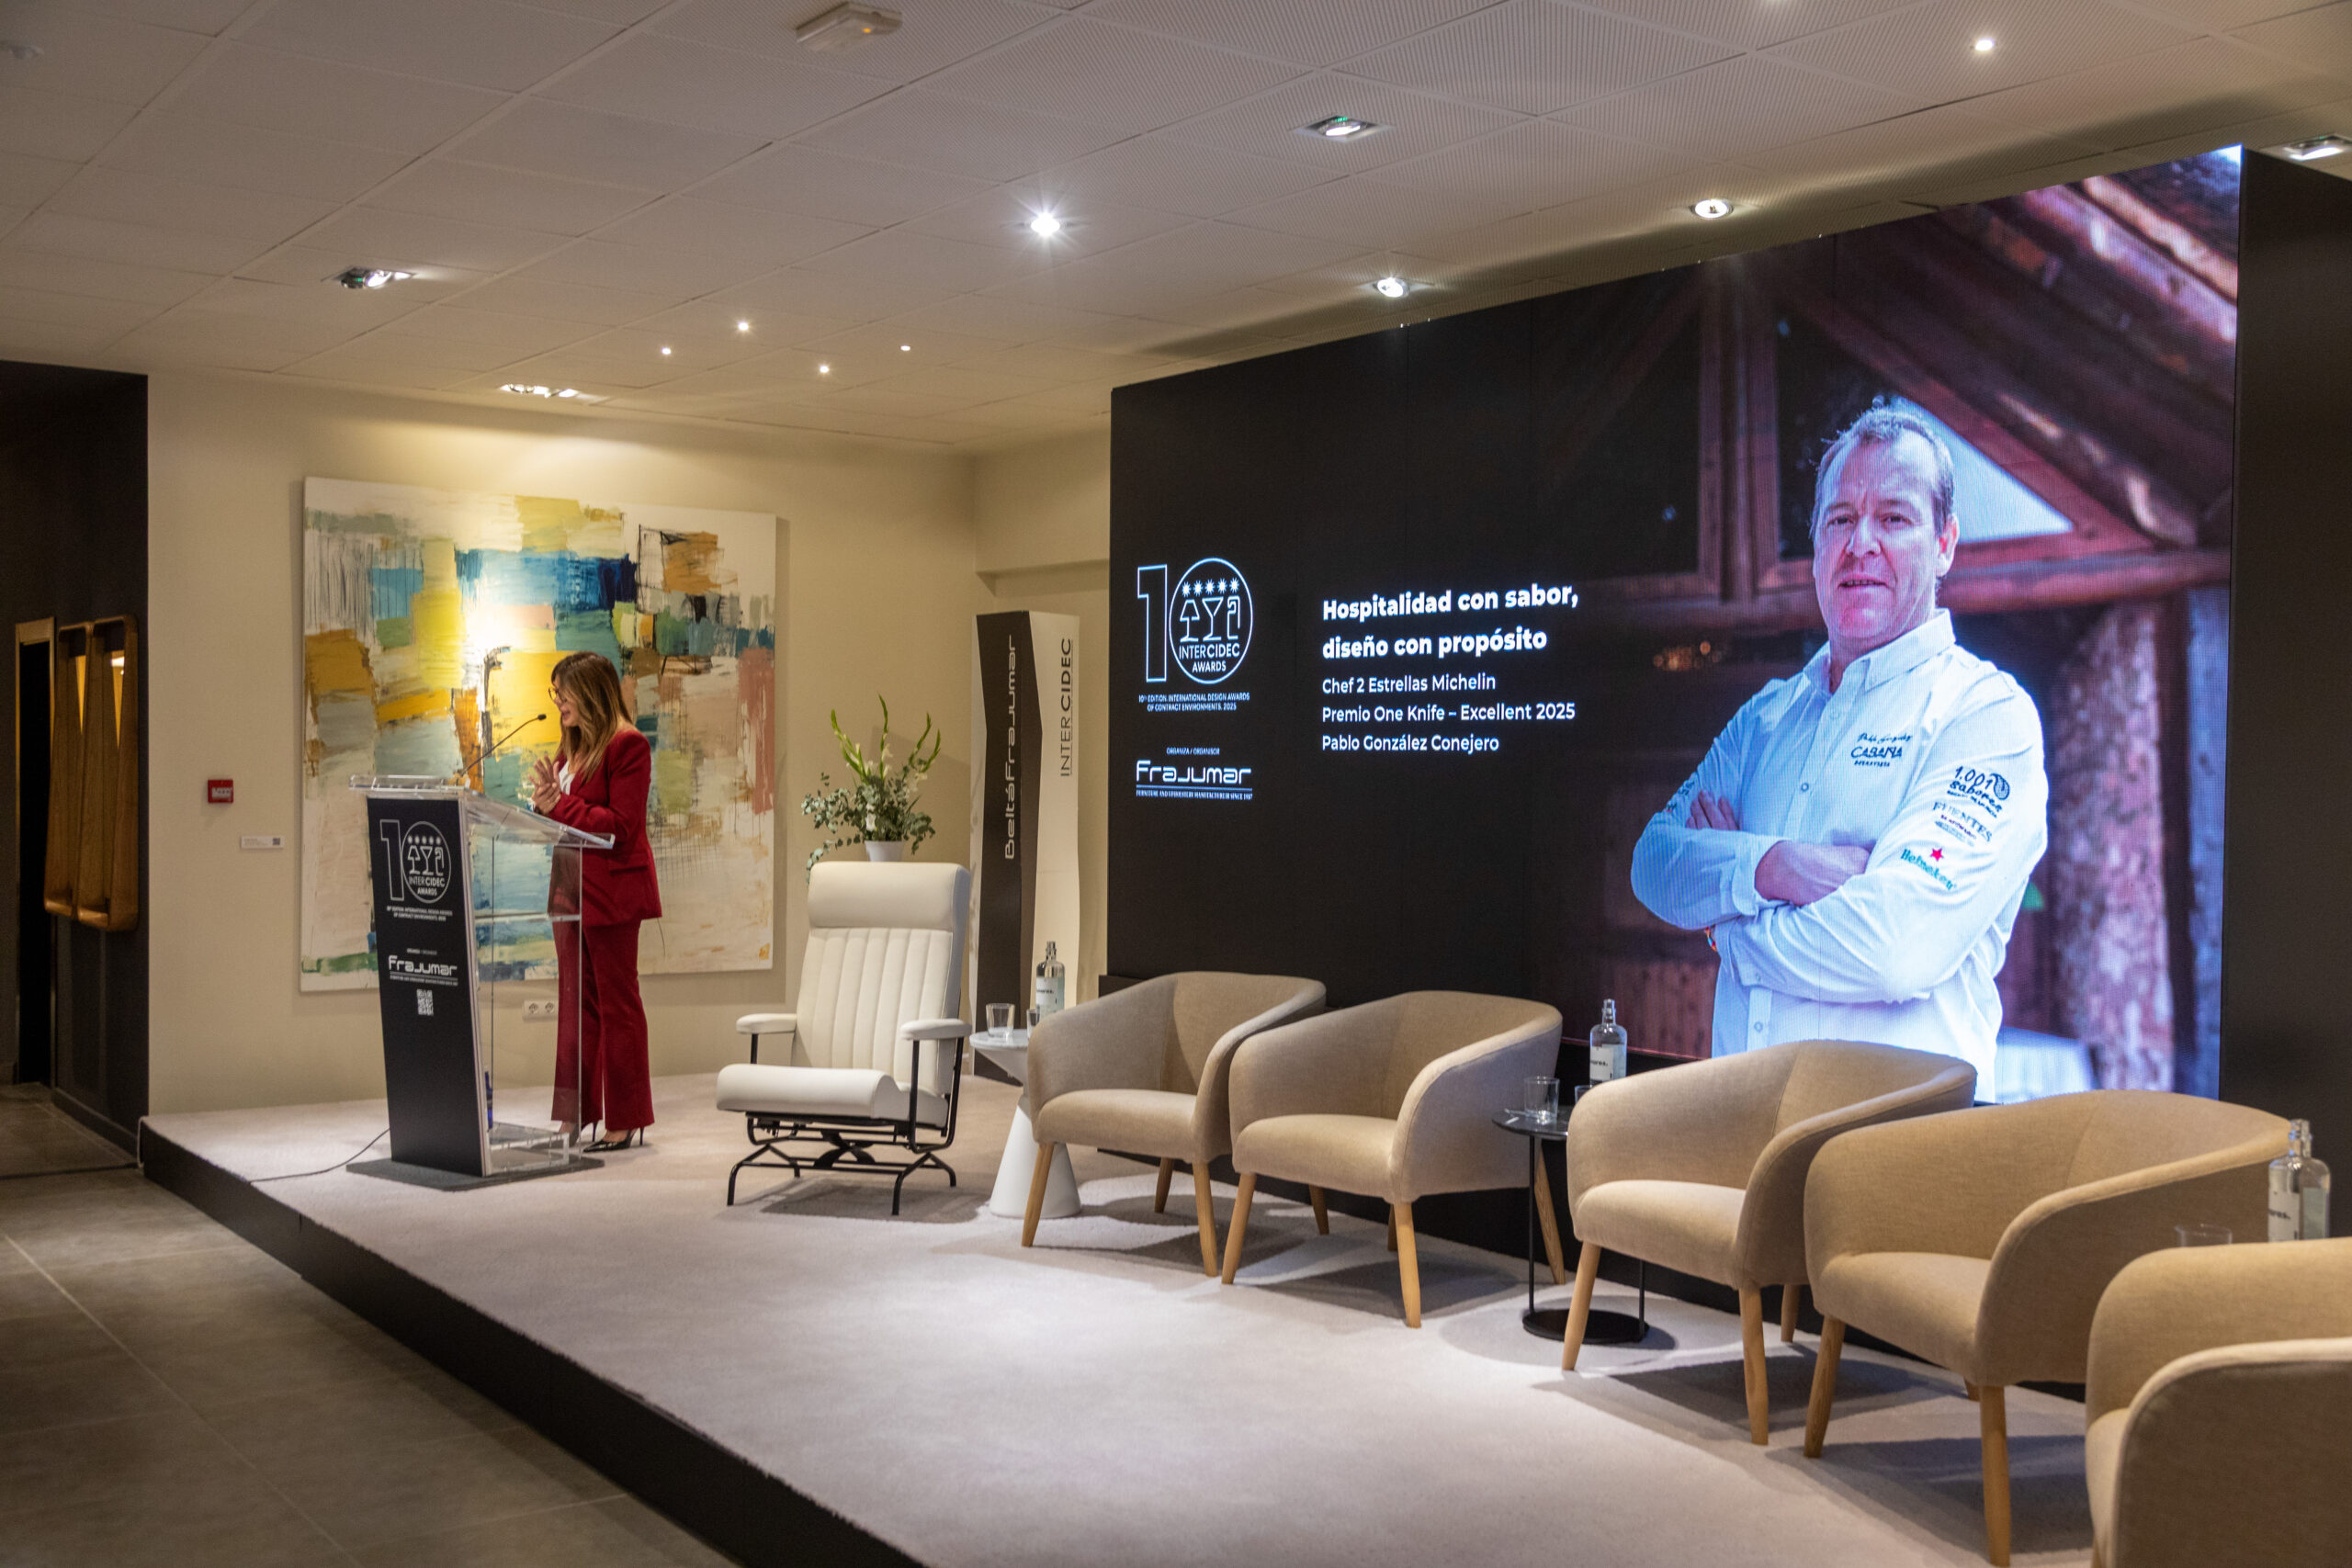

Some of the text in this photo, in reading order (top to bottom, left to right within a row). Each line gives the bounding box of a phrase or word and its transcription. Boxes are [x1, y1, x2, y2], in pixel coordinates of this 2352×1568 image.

[1323, 582, 1578, 622] Hospitalidad con sabor,
[1179, 642, 1240, 660] INTERCIDEC
[1322, 625, 1548, 659] diseño con propósito
[1192, 660, 1227, 673] AWARDS
[1322, 671, 1496, 694] Chef 2 Estrellas Michelin
[1155, 703, 1181, 712] CONTRACT
[1223, 702, 1237, 711] 2025
[1168, 693, 1206, 703] INTERNATIONAL
[1207, 693, 1227, 701] DESIGN
[1227, 692, 1250, 701] AWARDS
[1322, 705, 1371, 722] Premio
[1374, 705, 1403, 721] One
[1408, 704, 1445, 721] Knife
[1461, 702, 1532, 720] Excellent
[1535, 703, 1576, 719] 2025
[1322, 733, 1499, 754] Pablo González Conejero
[417, 887, 437, 897] AWARDS
